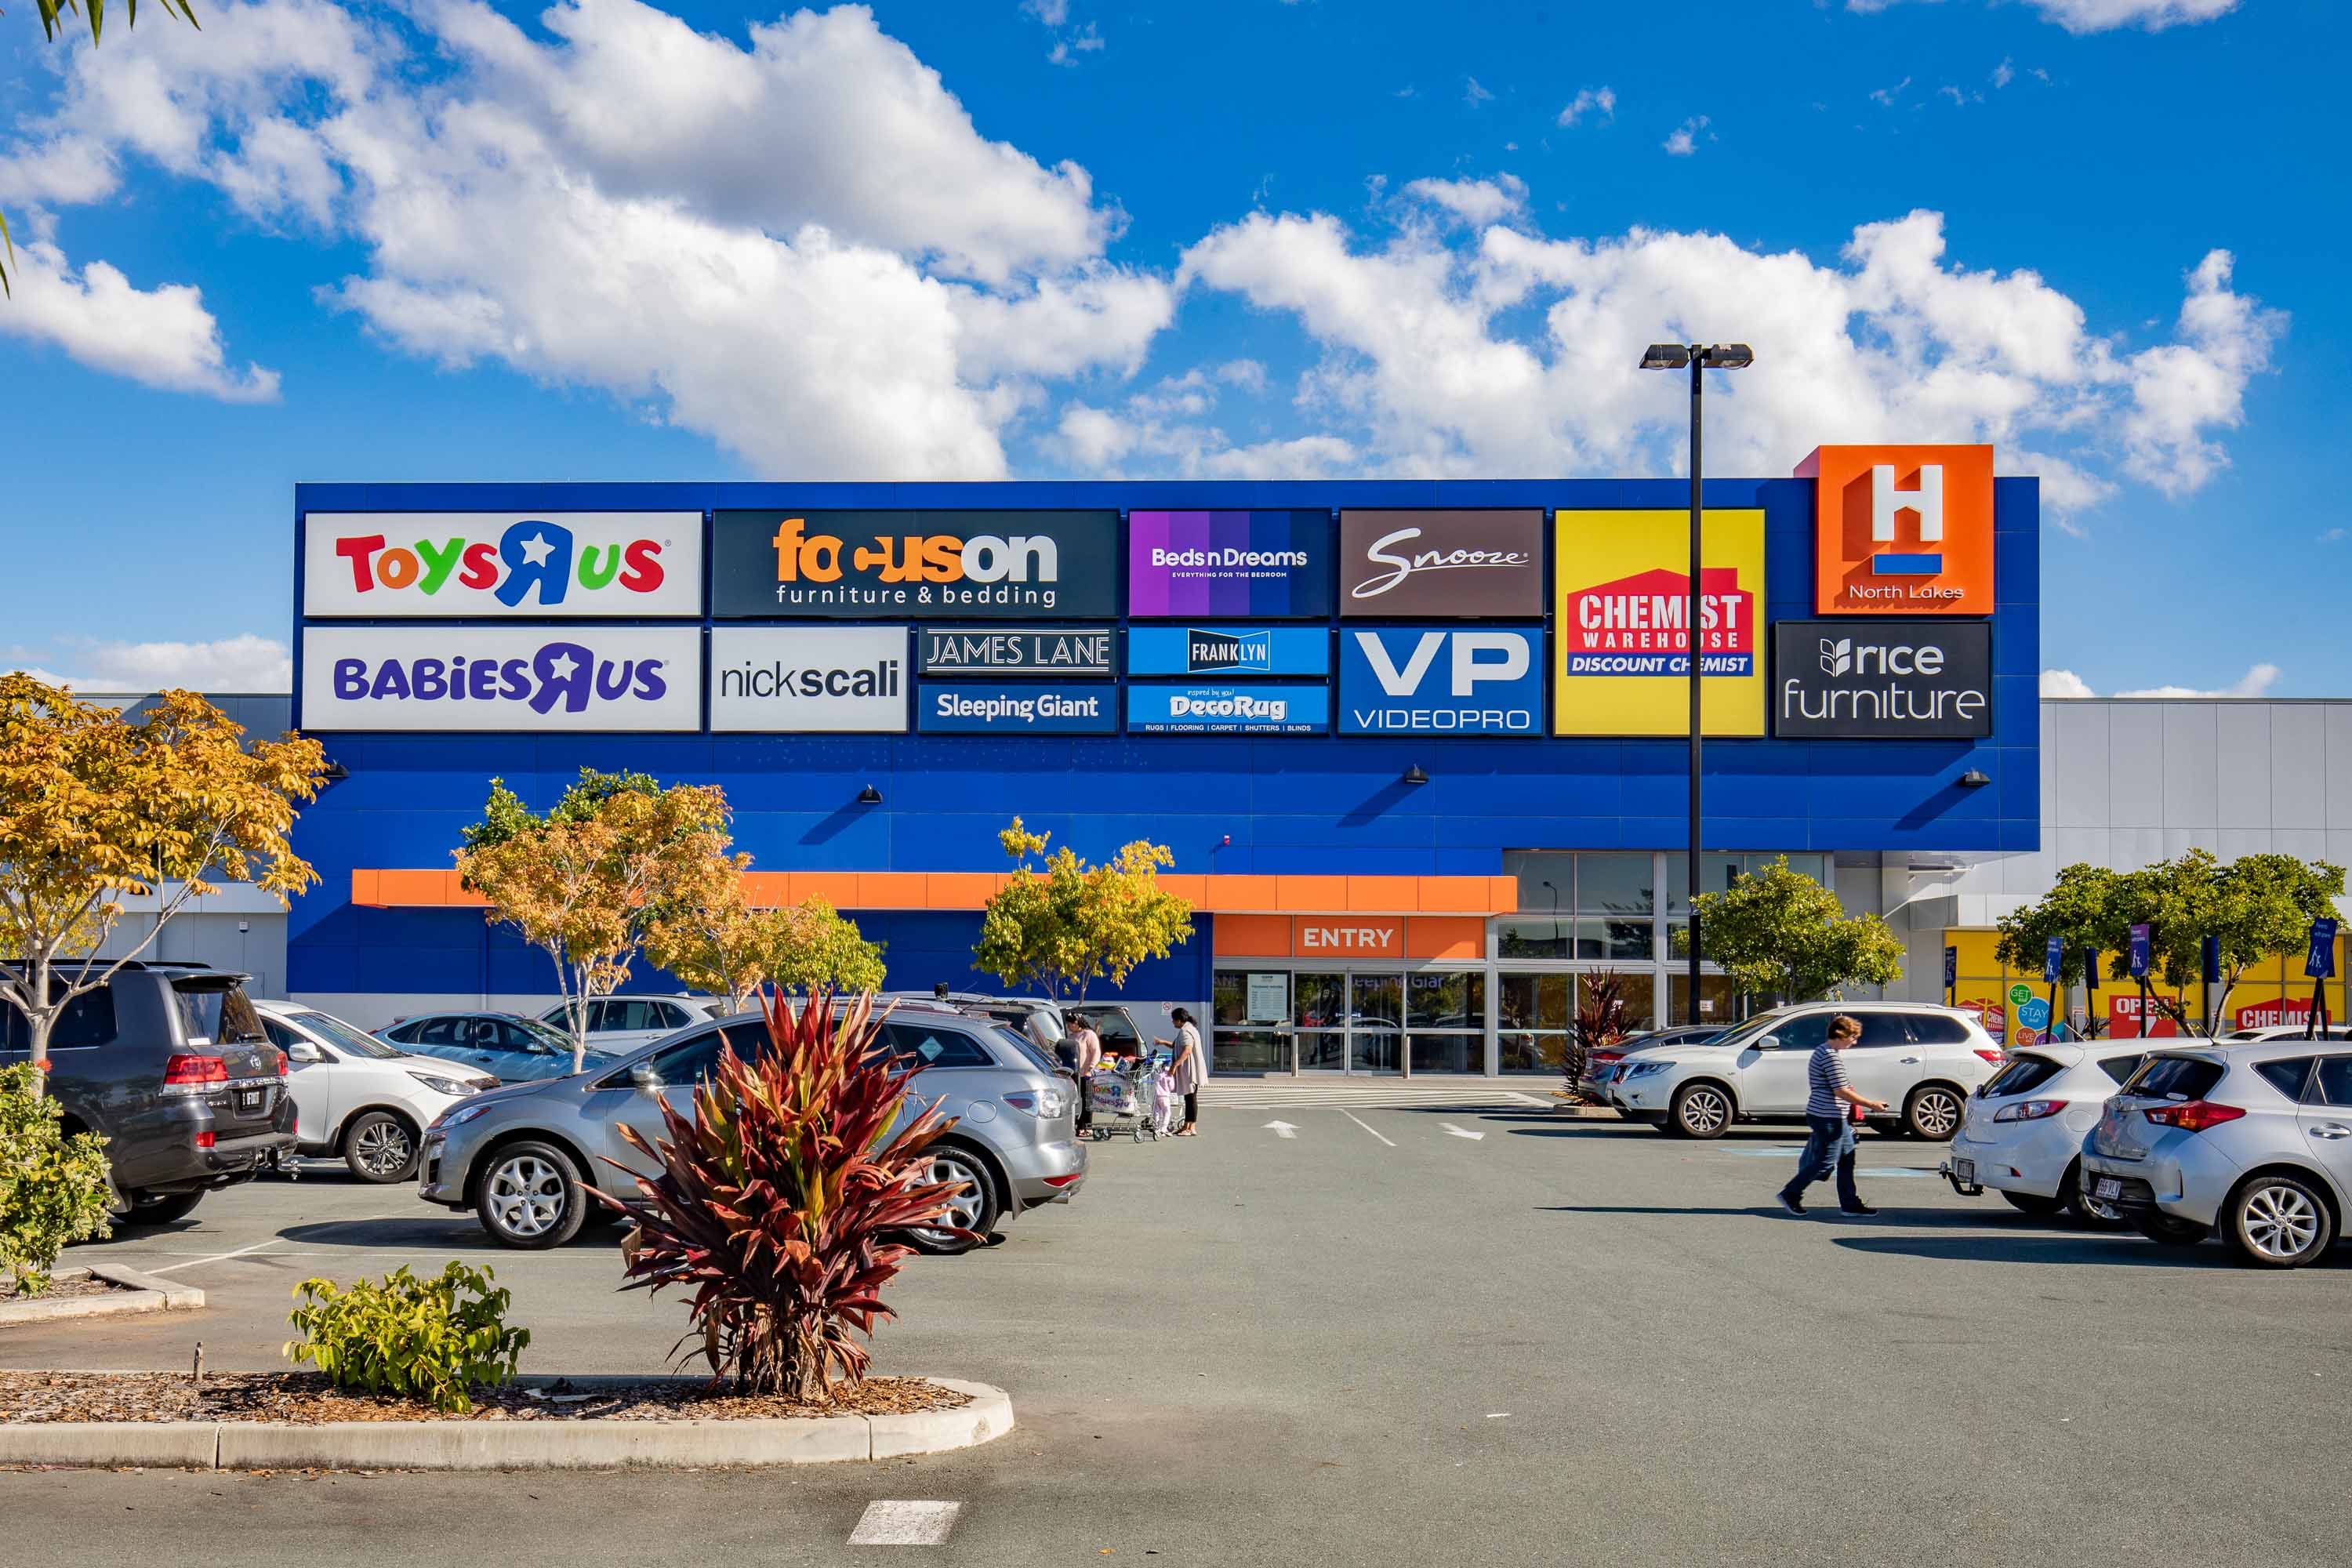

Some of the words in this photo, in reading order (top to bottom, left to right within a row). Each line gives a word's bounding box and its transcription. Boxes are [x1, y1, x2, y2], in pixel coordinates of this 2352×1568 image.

[1871, 464, 1944, 542] H
[1352, 528, 1529, 598] Snooze
[776, 586, 906, 603] furniture
[916, 586, 932, 604] &
[943, 586, 1055, 608] bedding
[1849, 584, 1903, 599] North
[1908, 584, 1964, 599] Lakes
[927, 635, 1023, 665] JAMES
[1035, 635, 1110, 665] LANE
[1583, 632, 1738, 648] WAREHOSE
[1192, 643, 1267, 662] FRANKLYN
[1856, 645, 1944, 676] rice
[1354, 632, 1530, 696] VP
[1571, 658, 1666, 672] DISCOUNT
[936, 693, 1035, 723] Sleeping
[1037, 694, 1099, 717] Giant
[1169, 695, 1288, 721] DecoRug
[1784, 678, 1986, 719] furniture
[1354, 709, 1530, 729] VIDEOPRO
[1304, 928, 1393, 948] ENTRY
[2010, 989, 2031, 998] GET
[2021, 1007, 2049, 1018] STAY
[2017, 1032, 2034, 1040] LIVE
